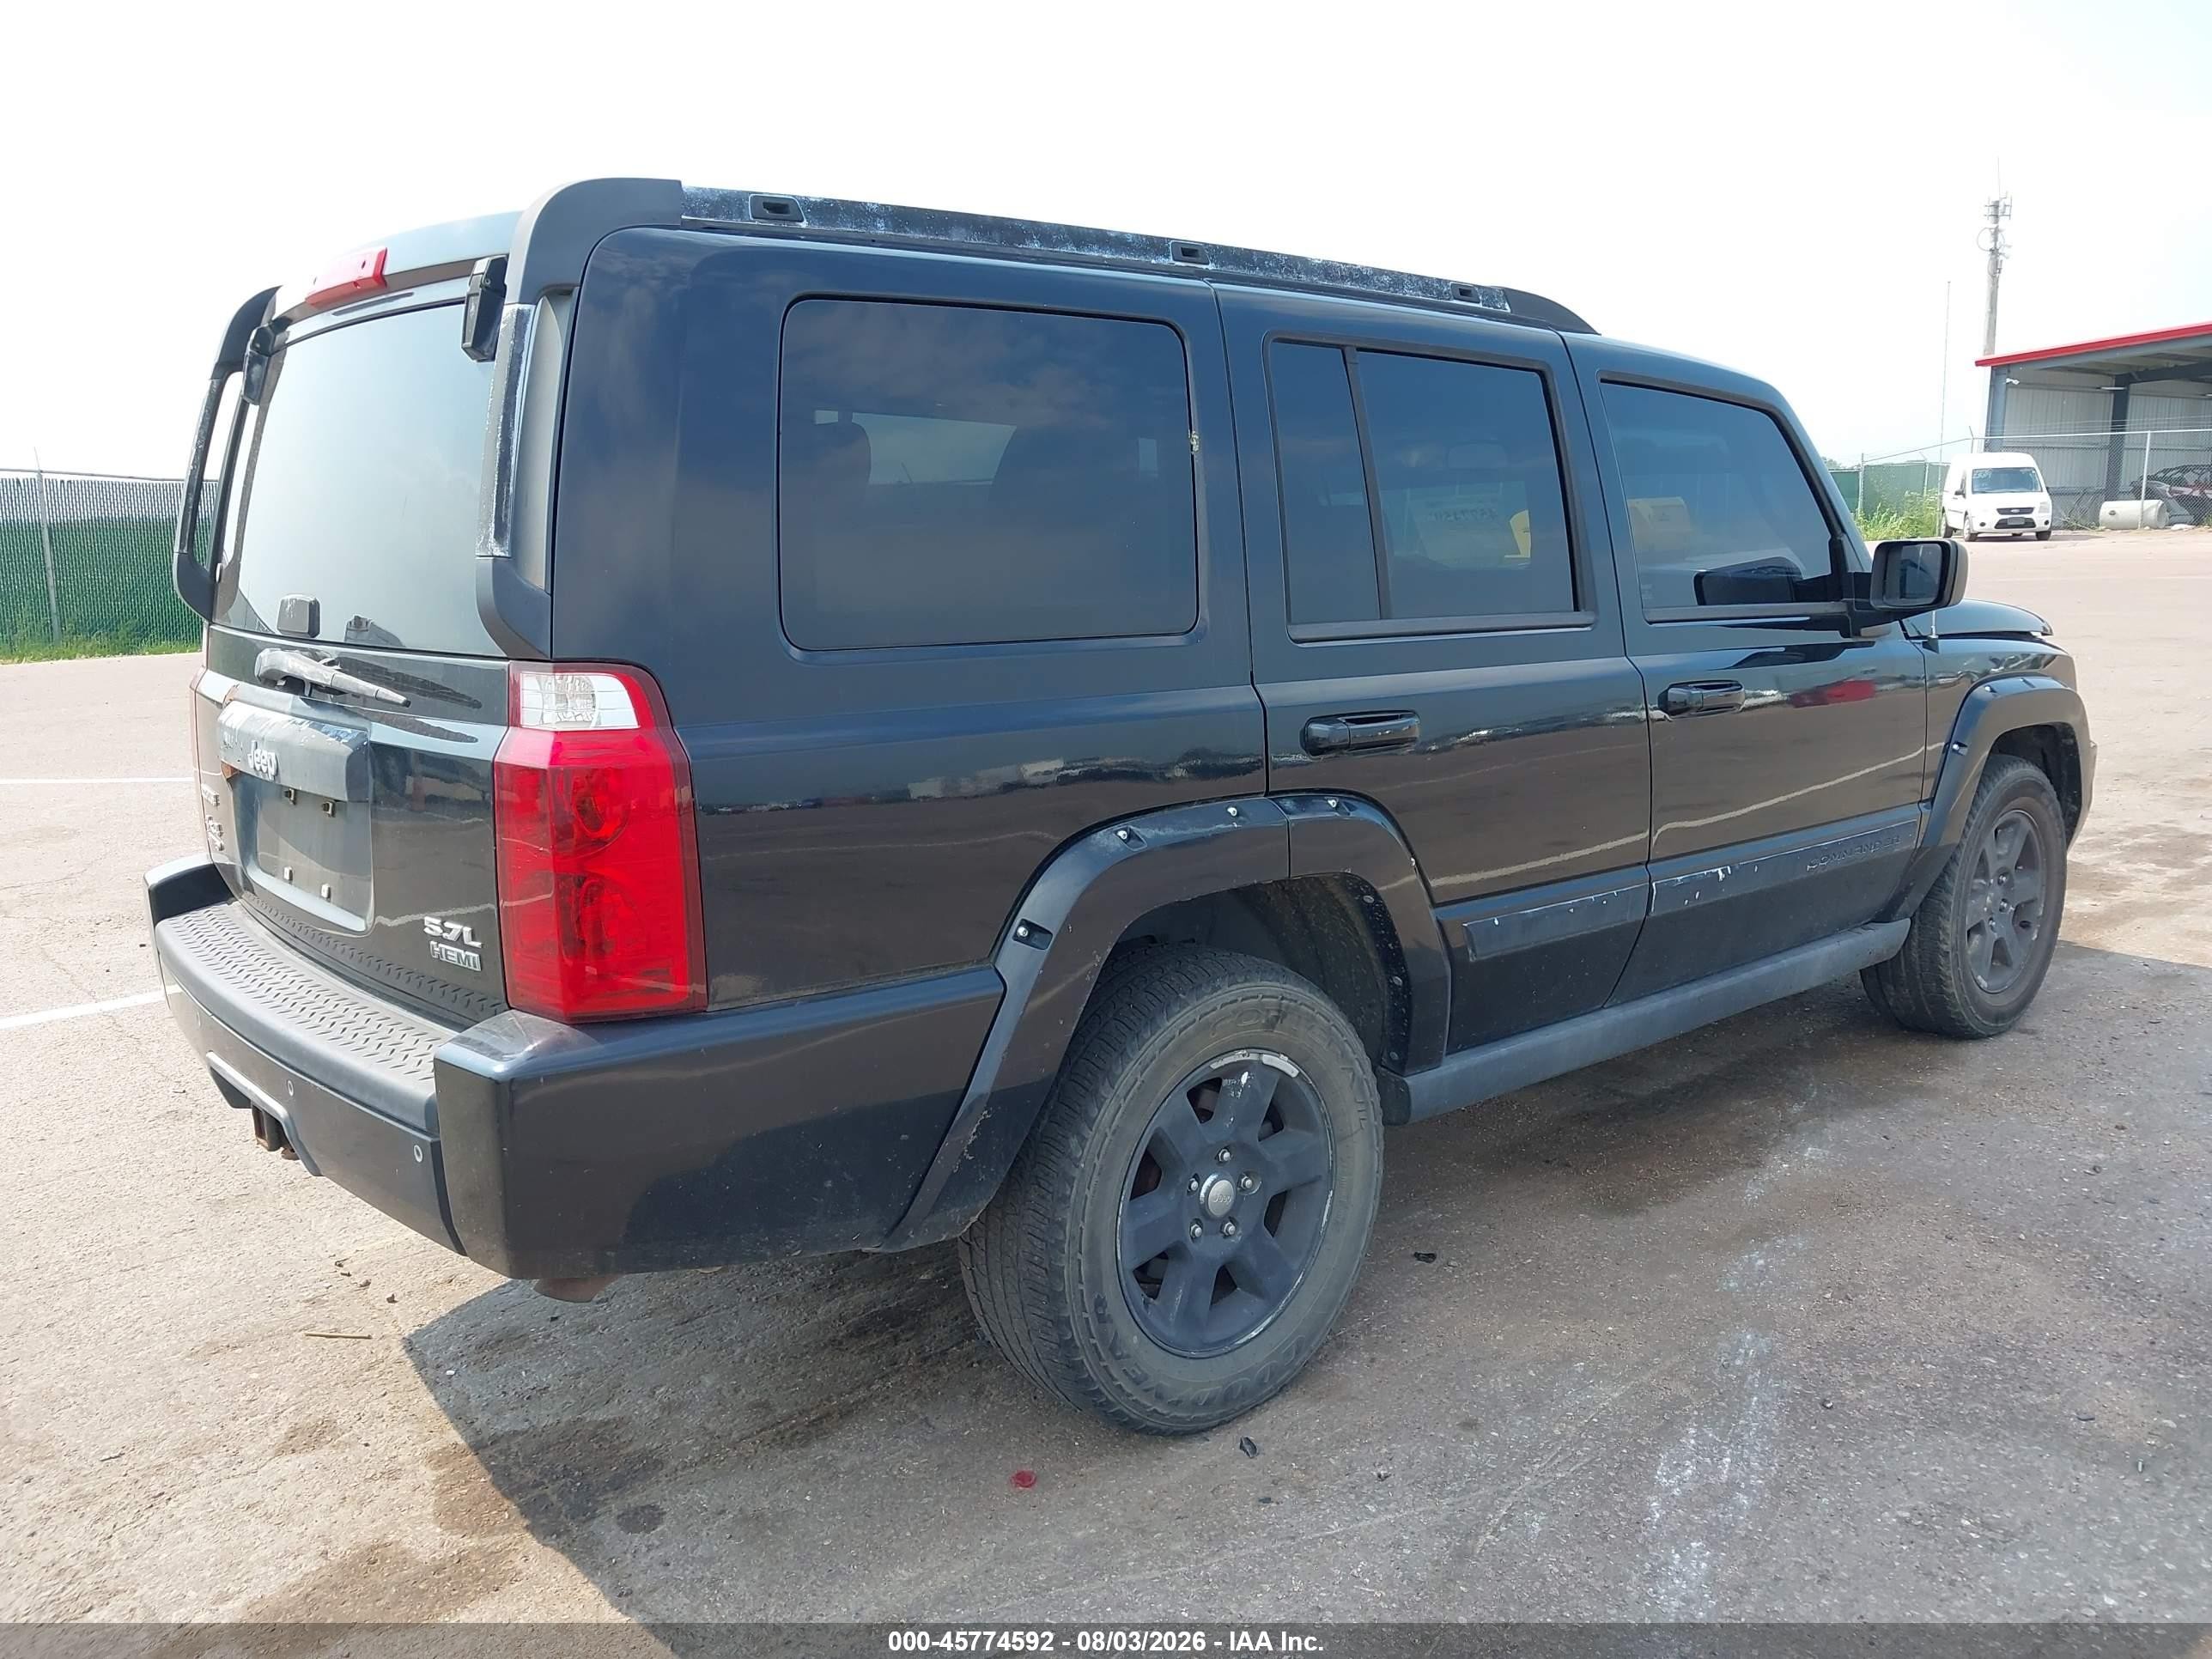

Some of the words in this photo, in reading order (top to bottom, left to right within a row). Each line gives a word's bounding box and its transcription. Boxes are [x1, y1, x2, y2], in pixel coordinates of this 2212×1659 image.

[246, 739, 276, 781] Jeep
[423, 915, 483, 949] 5.7L
[429, 940, 482, 971] HEMI
